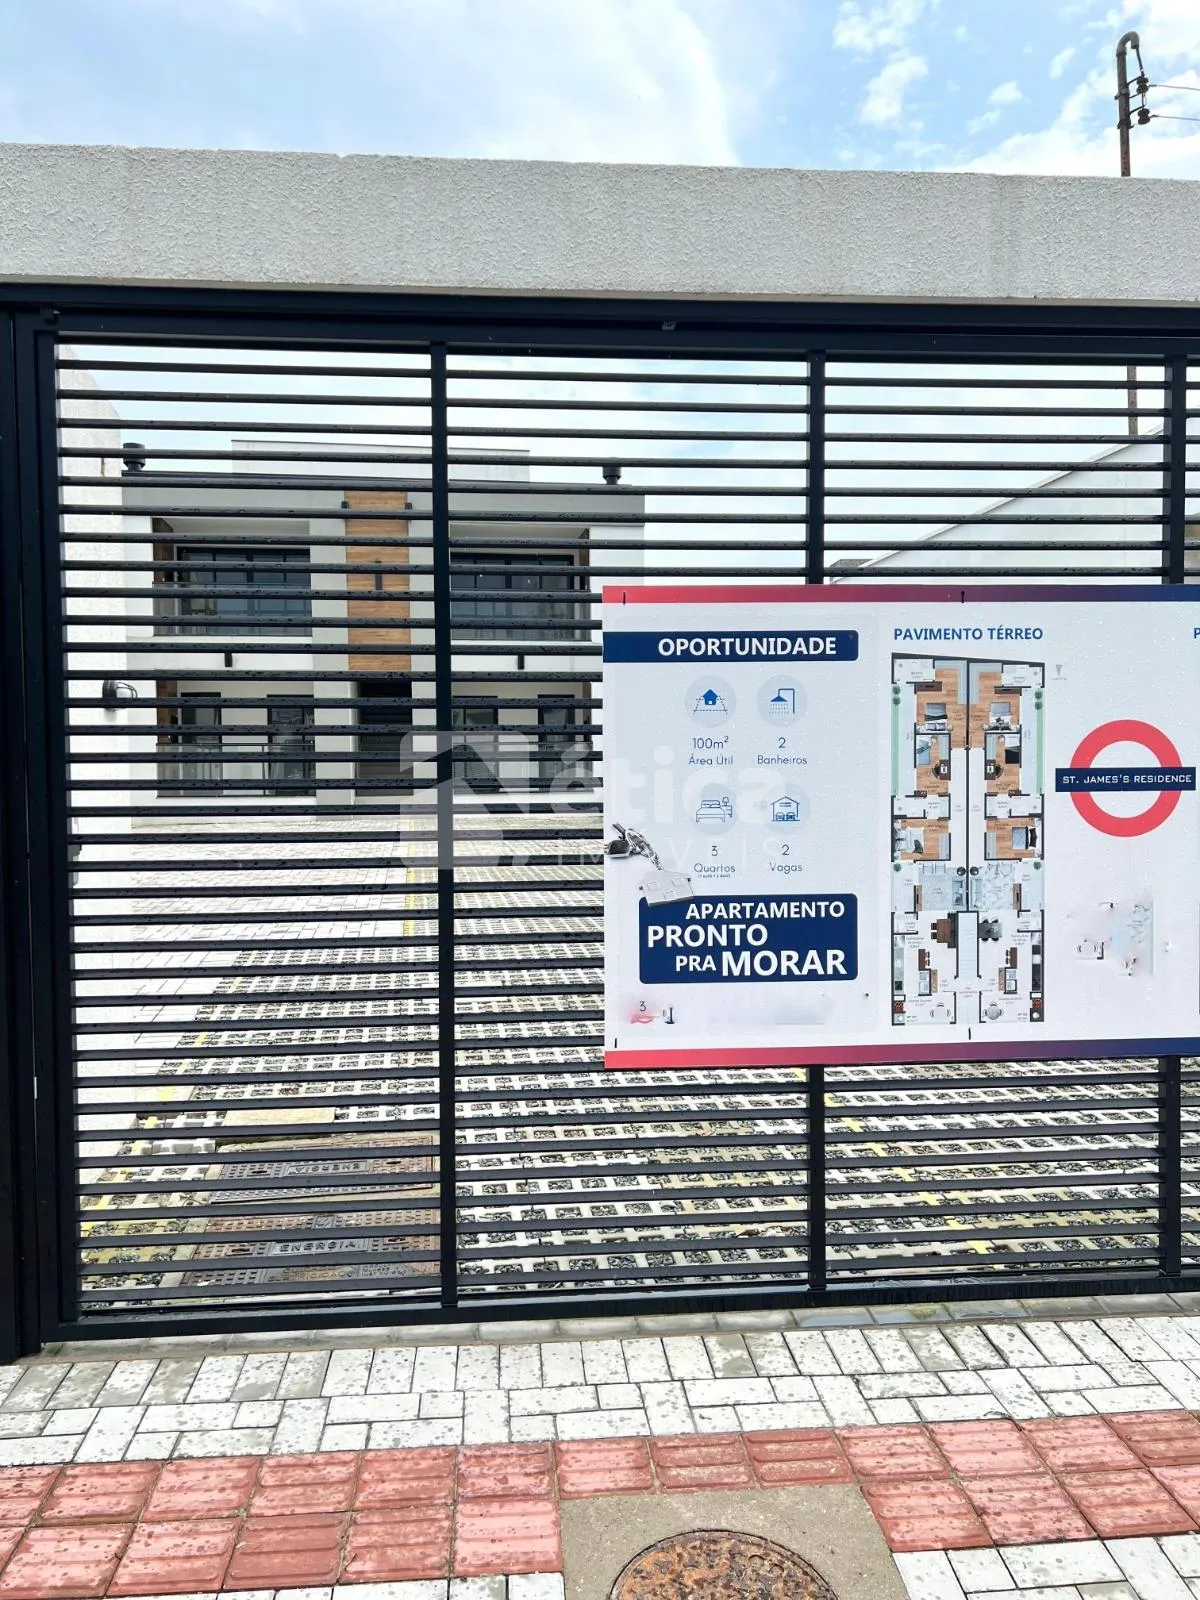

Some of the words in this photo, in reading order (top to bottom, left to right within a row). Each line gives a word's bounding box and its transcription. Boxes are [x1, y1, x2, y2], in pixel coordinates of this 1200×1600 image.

[893, 627, 983, 640] PAVIMENTO
[987, 625, 1044, 640] TÉRREO
[658, 637, 837, 656] OPORTUNIDADE
[692, 735, 729, 749] 100m²
[778, 737, 786, 748] 2
[688, 753, 713, 765] Área
[716, 753, 734, 765] Útil
[757, 754, 808, 765] Banheiros
[1062, 775, 1079, 784] ST.
[1083, 774, 1130, 784] JAMES'S
[1133, 774, 1192, 783] RESIDENCE
[711, 845, 719, 857] 3
[782, 844, 790, 856] 2
[693, 862, 736, 873] Quartos
[769, 861, 803, 874] Vagas
[685, 901, 845, 919] APARTAMENTO
[647, 924, 768, 948] PRONTO
[675, 955, 717, 972] PRA
[721, 949, 848, 977] MORAR
